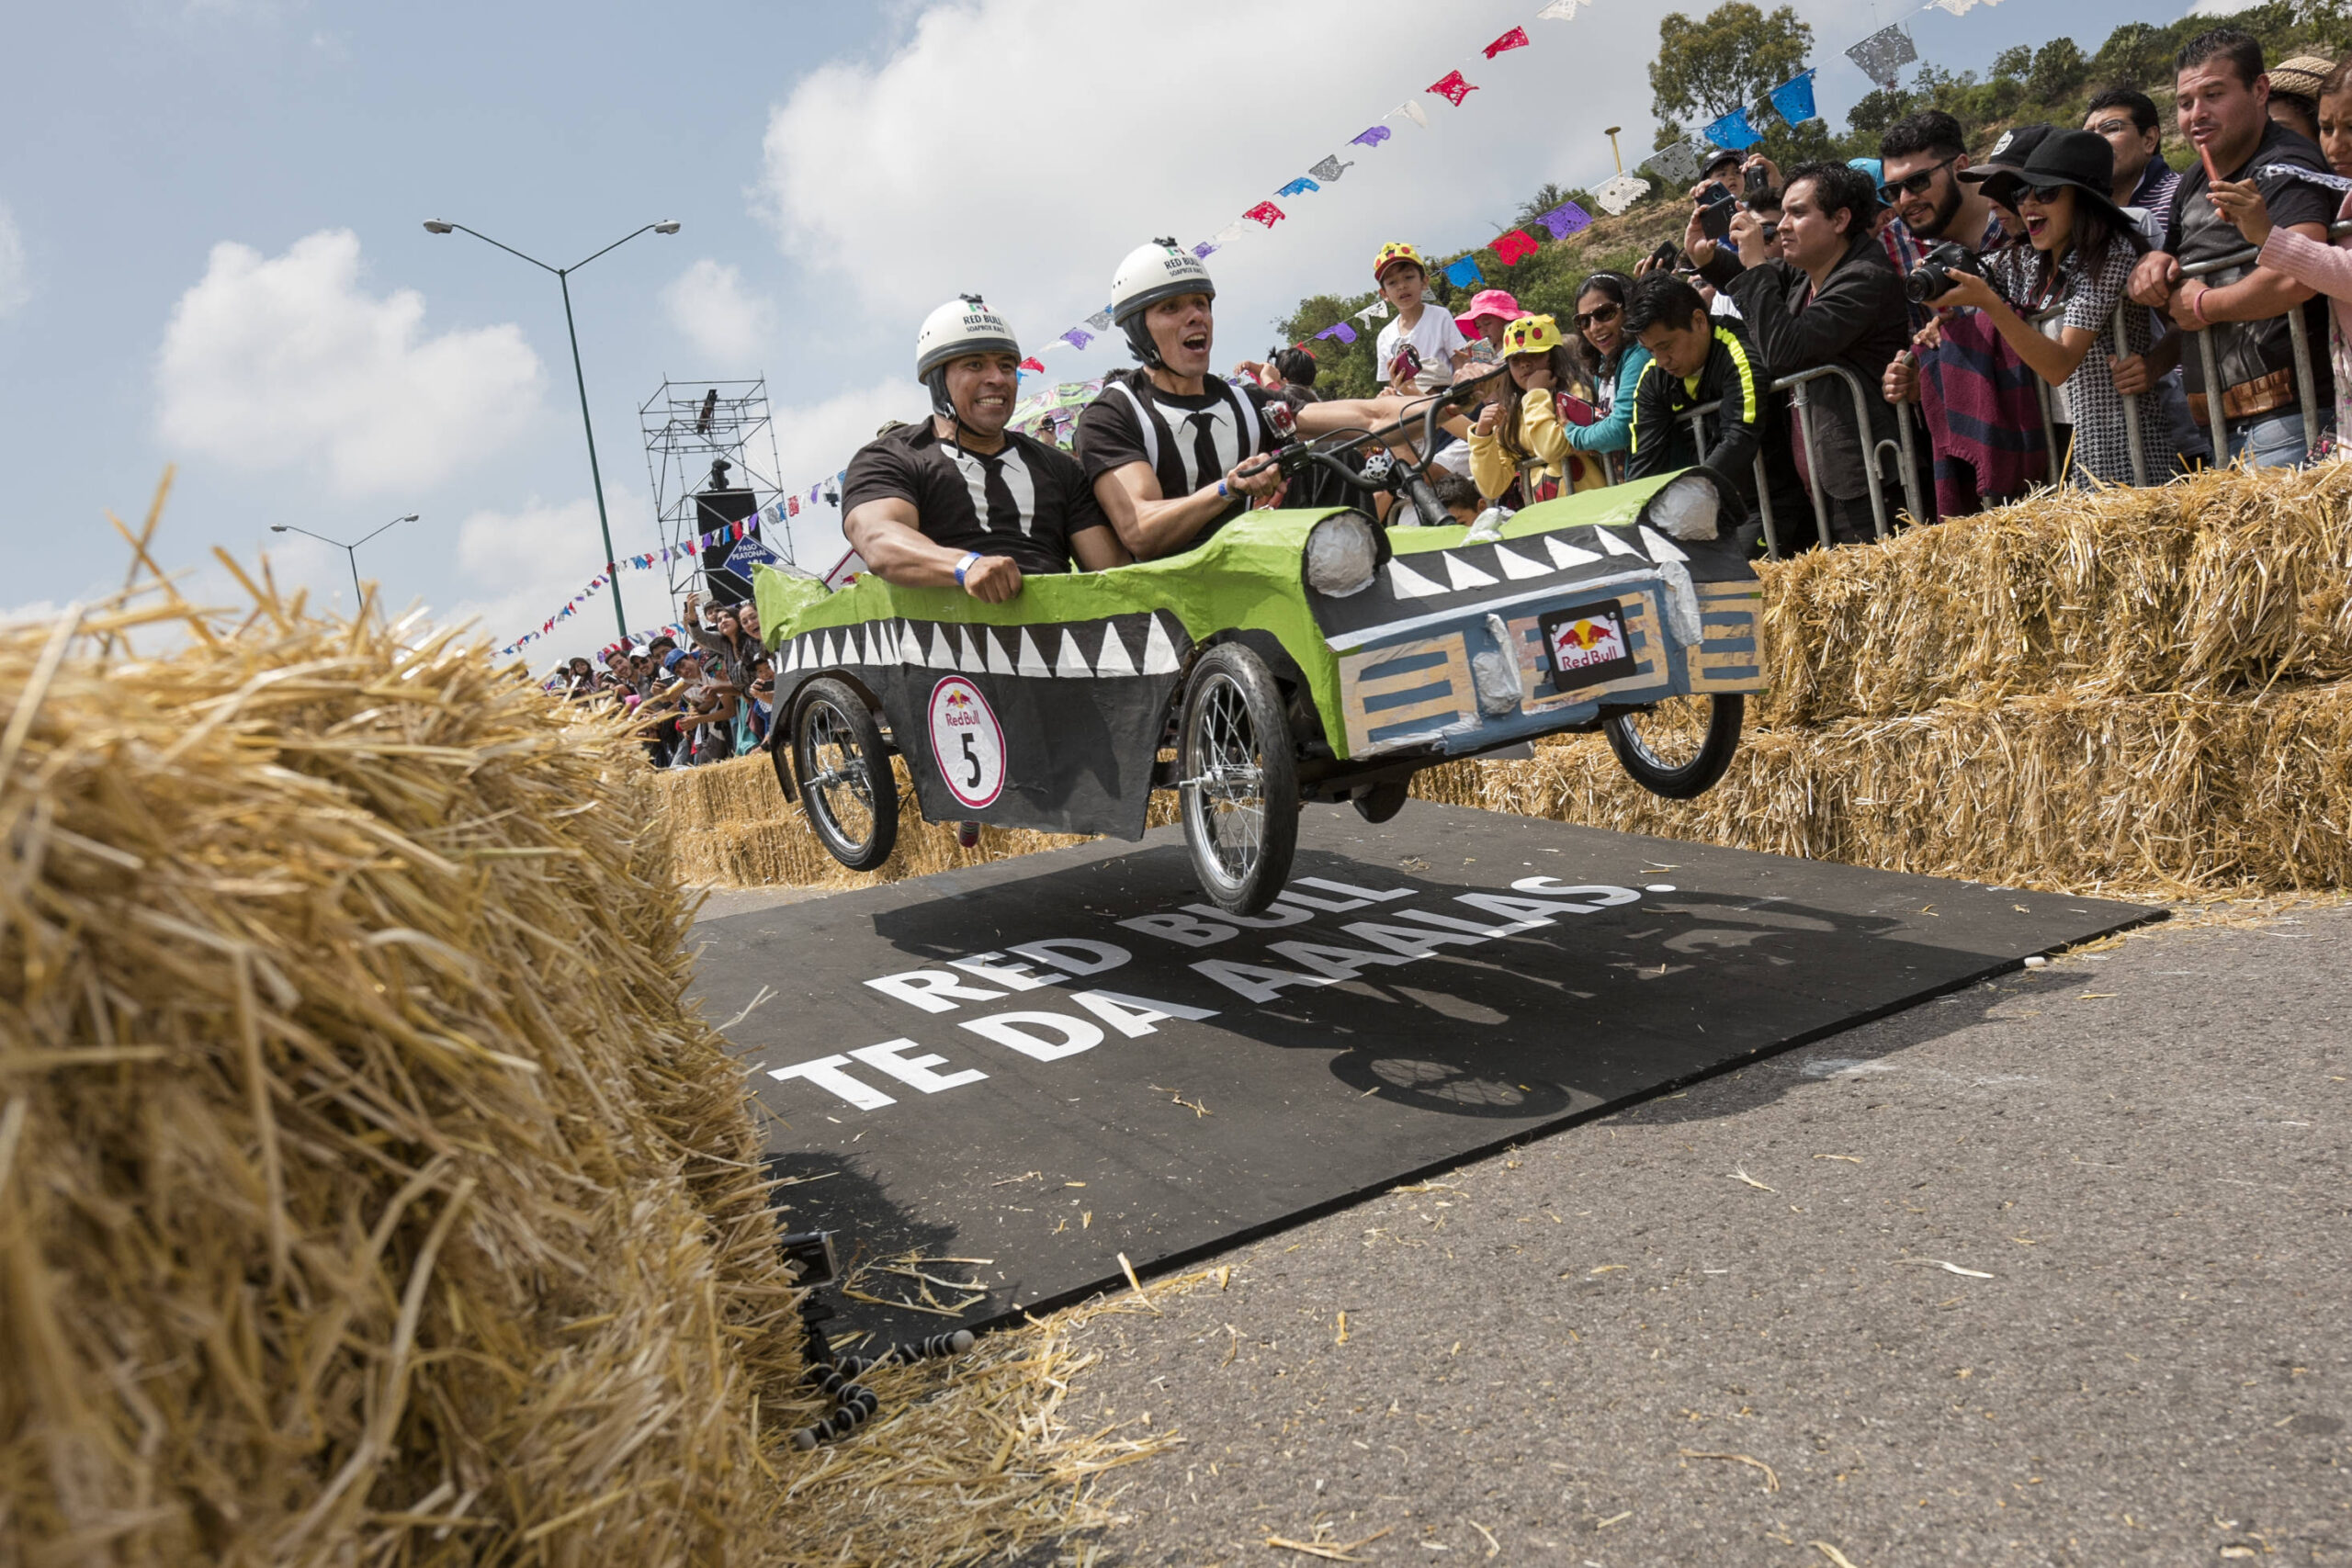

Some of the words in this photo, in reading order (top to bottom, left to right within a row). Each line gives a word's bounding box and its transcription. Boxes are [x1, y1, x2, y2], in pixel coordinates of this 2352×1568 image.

[1164, 258, 1182, 270] RED
[1182, 257, 1200, 266] BULL
[2040, 294, 2053, 310] EOS
[963, 314, 982, 325] RED
[983, 314, 1003, 326] BULL
[731, 550, 767, 560] PEATONAL
[738, 544, 757, 552] PASO
[1562, 651, 1589, 670] Red
[1590, 646, 1617, 663] Bull
[945, 711, 964, 727] Red
[963, 710, 980, 726] Bull
[961, 732, 981, 788] 5
[863, 938, 1132, 1013] RED
[1114, 876, 1419, 947] BULL
[766, 1037, 990, 1111] TE
[956, 989, 1222, 1063] DA
[1188, 875, 1677, 1004] AAALAS.
